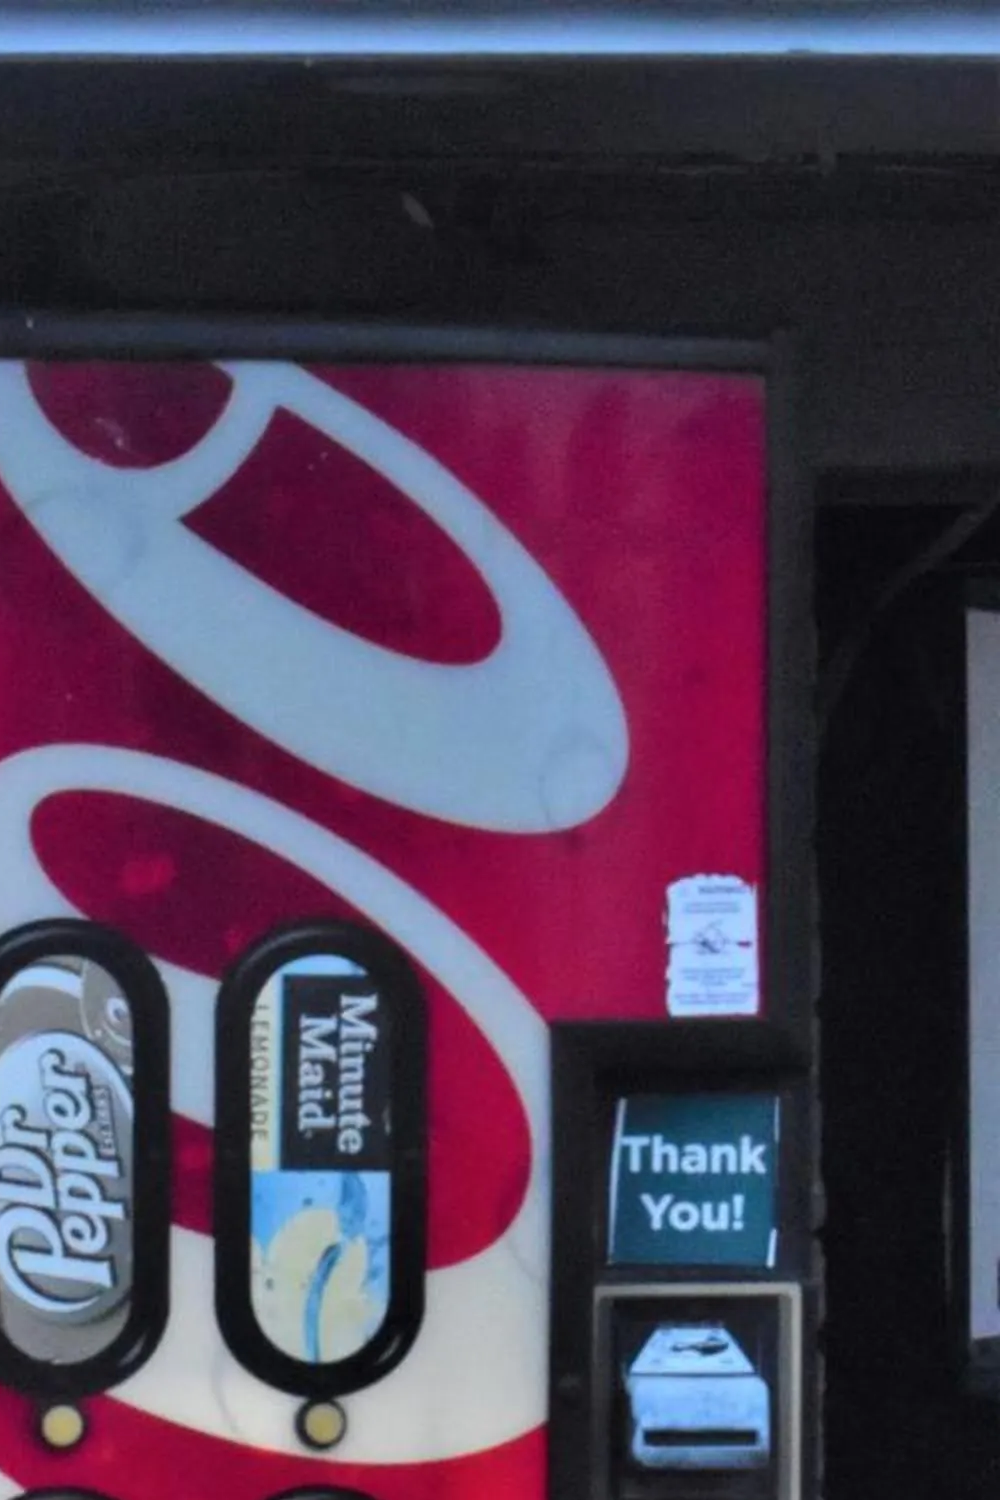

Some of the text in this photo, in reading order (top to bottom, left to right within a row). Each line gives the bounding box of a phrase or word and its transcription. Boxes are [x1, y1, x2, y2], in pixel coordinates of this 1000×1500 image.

[298, 1014, 338, 1132] Maid
[338, 993, 379, 1155] Minute
[621, 1134, 767, 1175] Thank
[640, 1193, 746, 1232] You!
